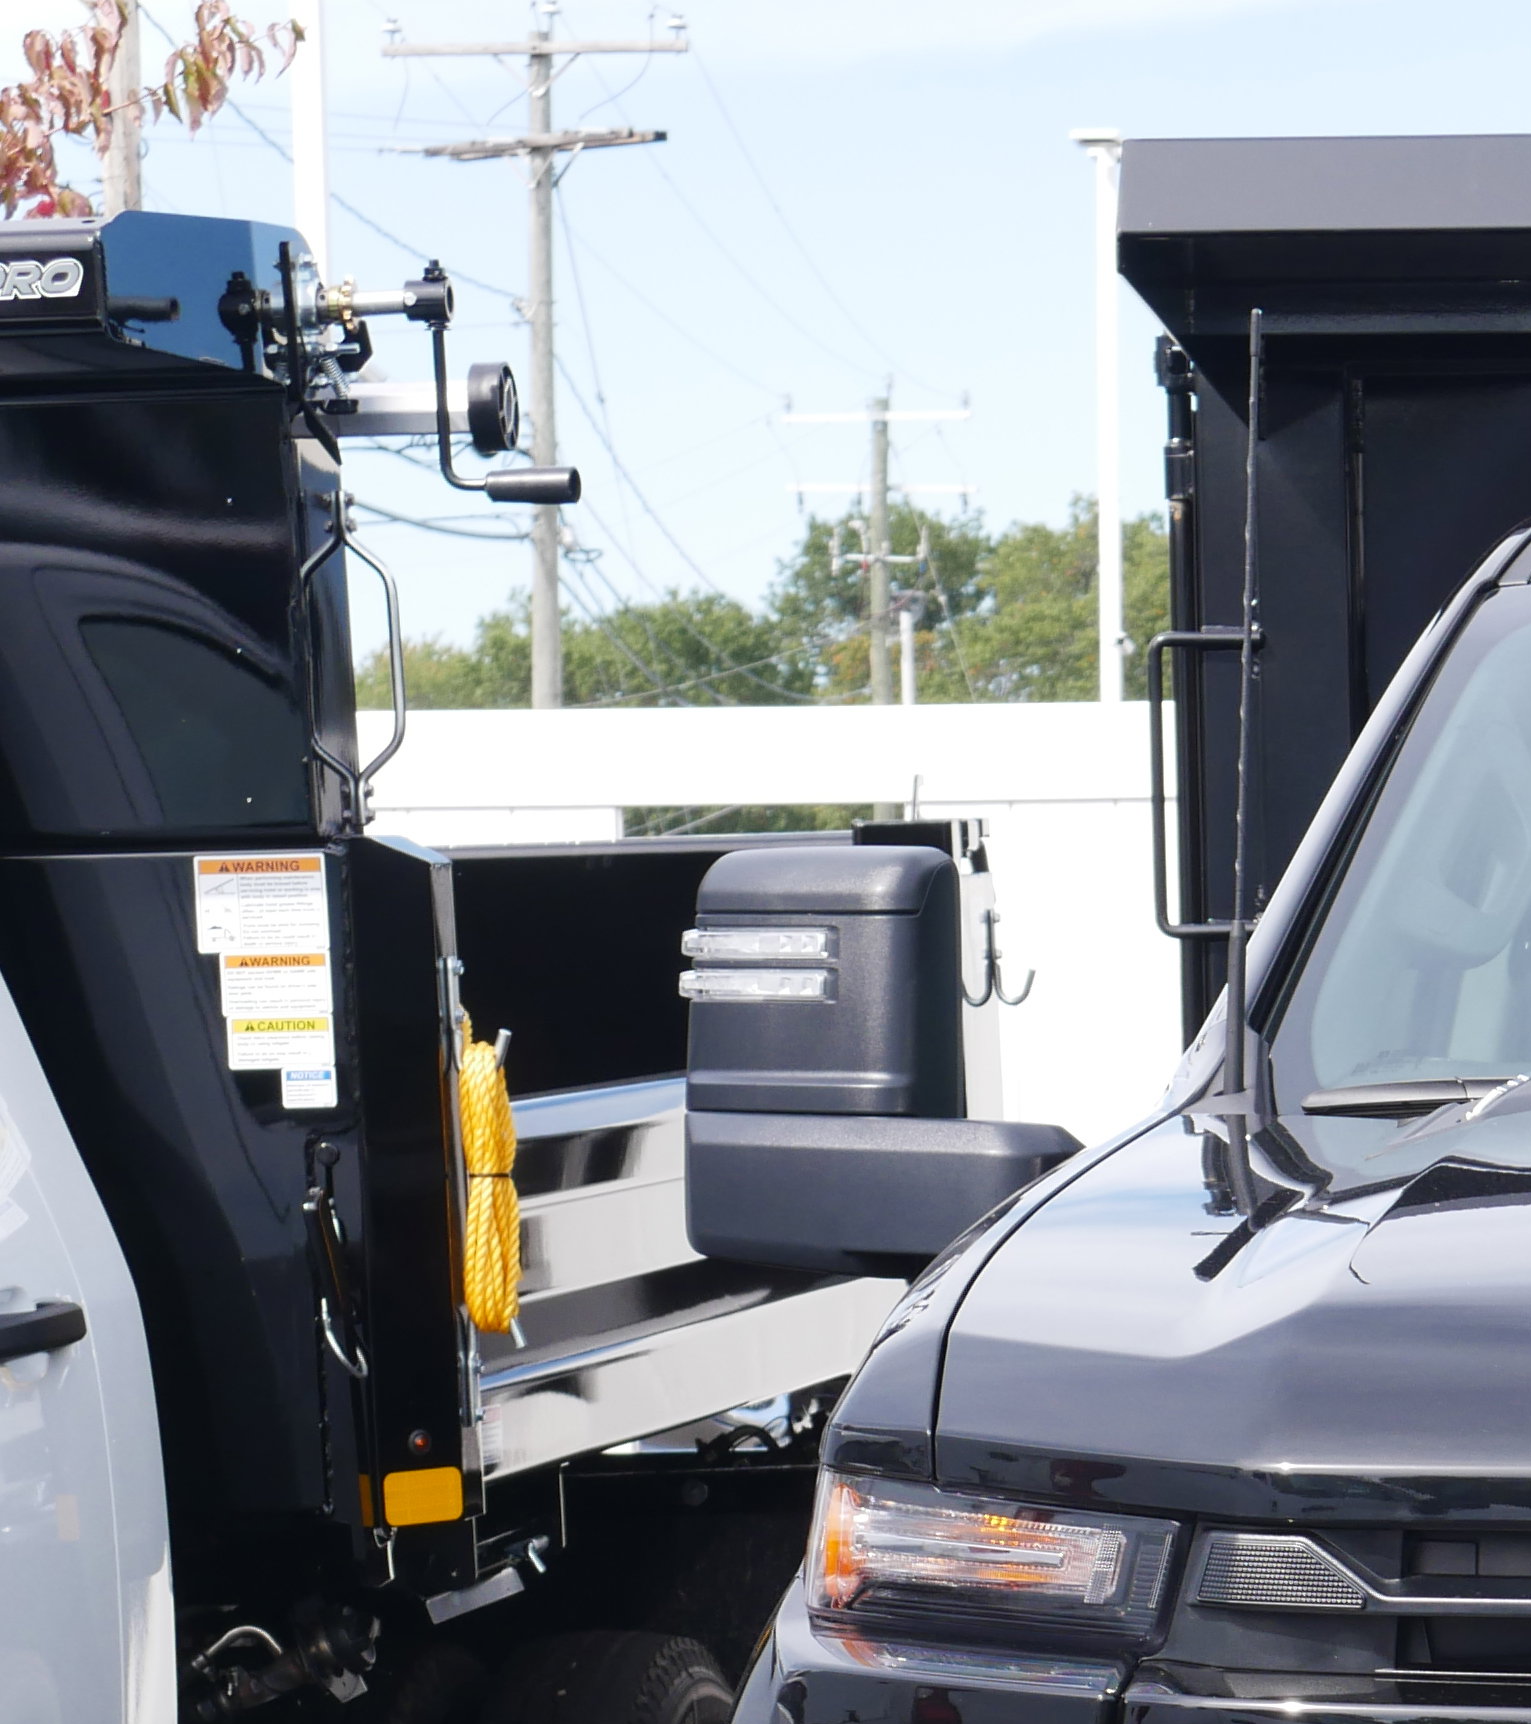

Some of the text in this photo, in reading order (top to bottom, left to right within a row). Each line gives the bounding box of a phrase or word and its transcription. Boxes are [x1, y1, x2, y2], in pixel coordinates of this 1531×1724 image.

[0, 258, 84, 300] RO
[232, 860, 301, 873] WARNING
[249, 956, 311, 968] WARNING
[256, 1020, 316, 1032] CAUTION
